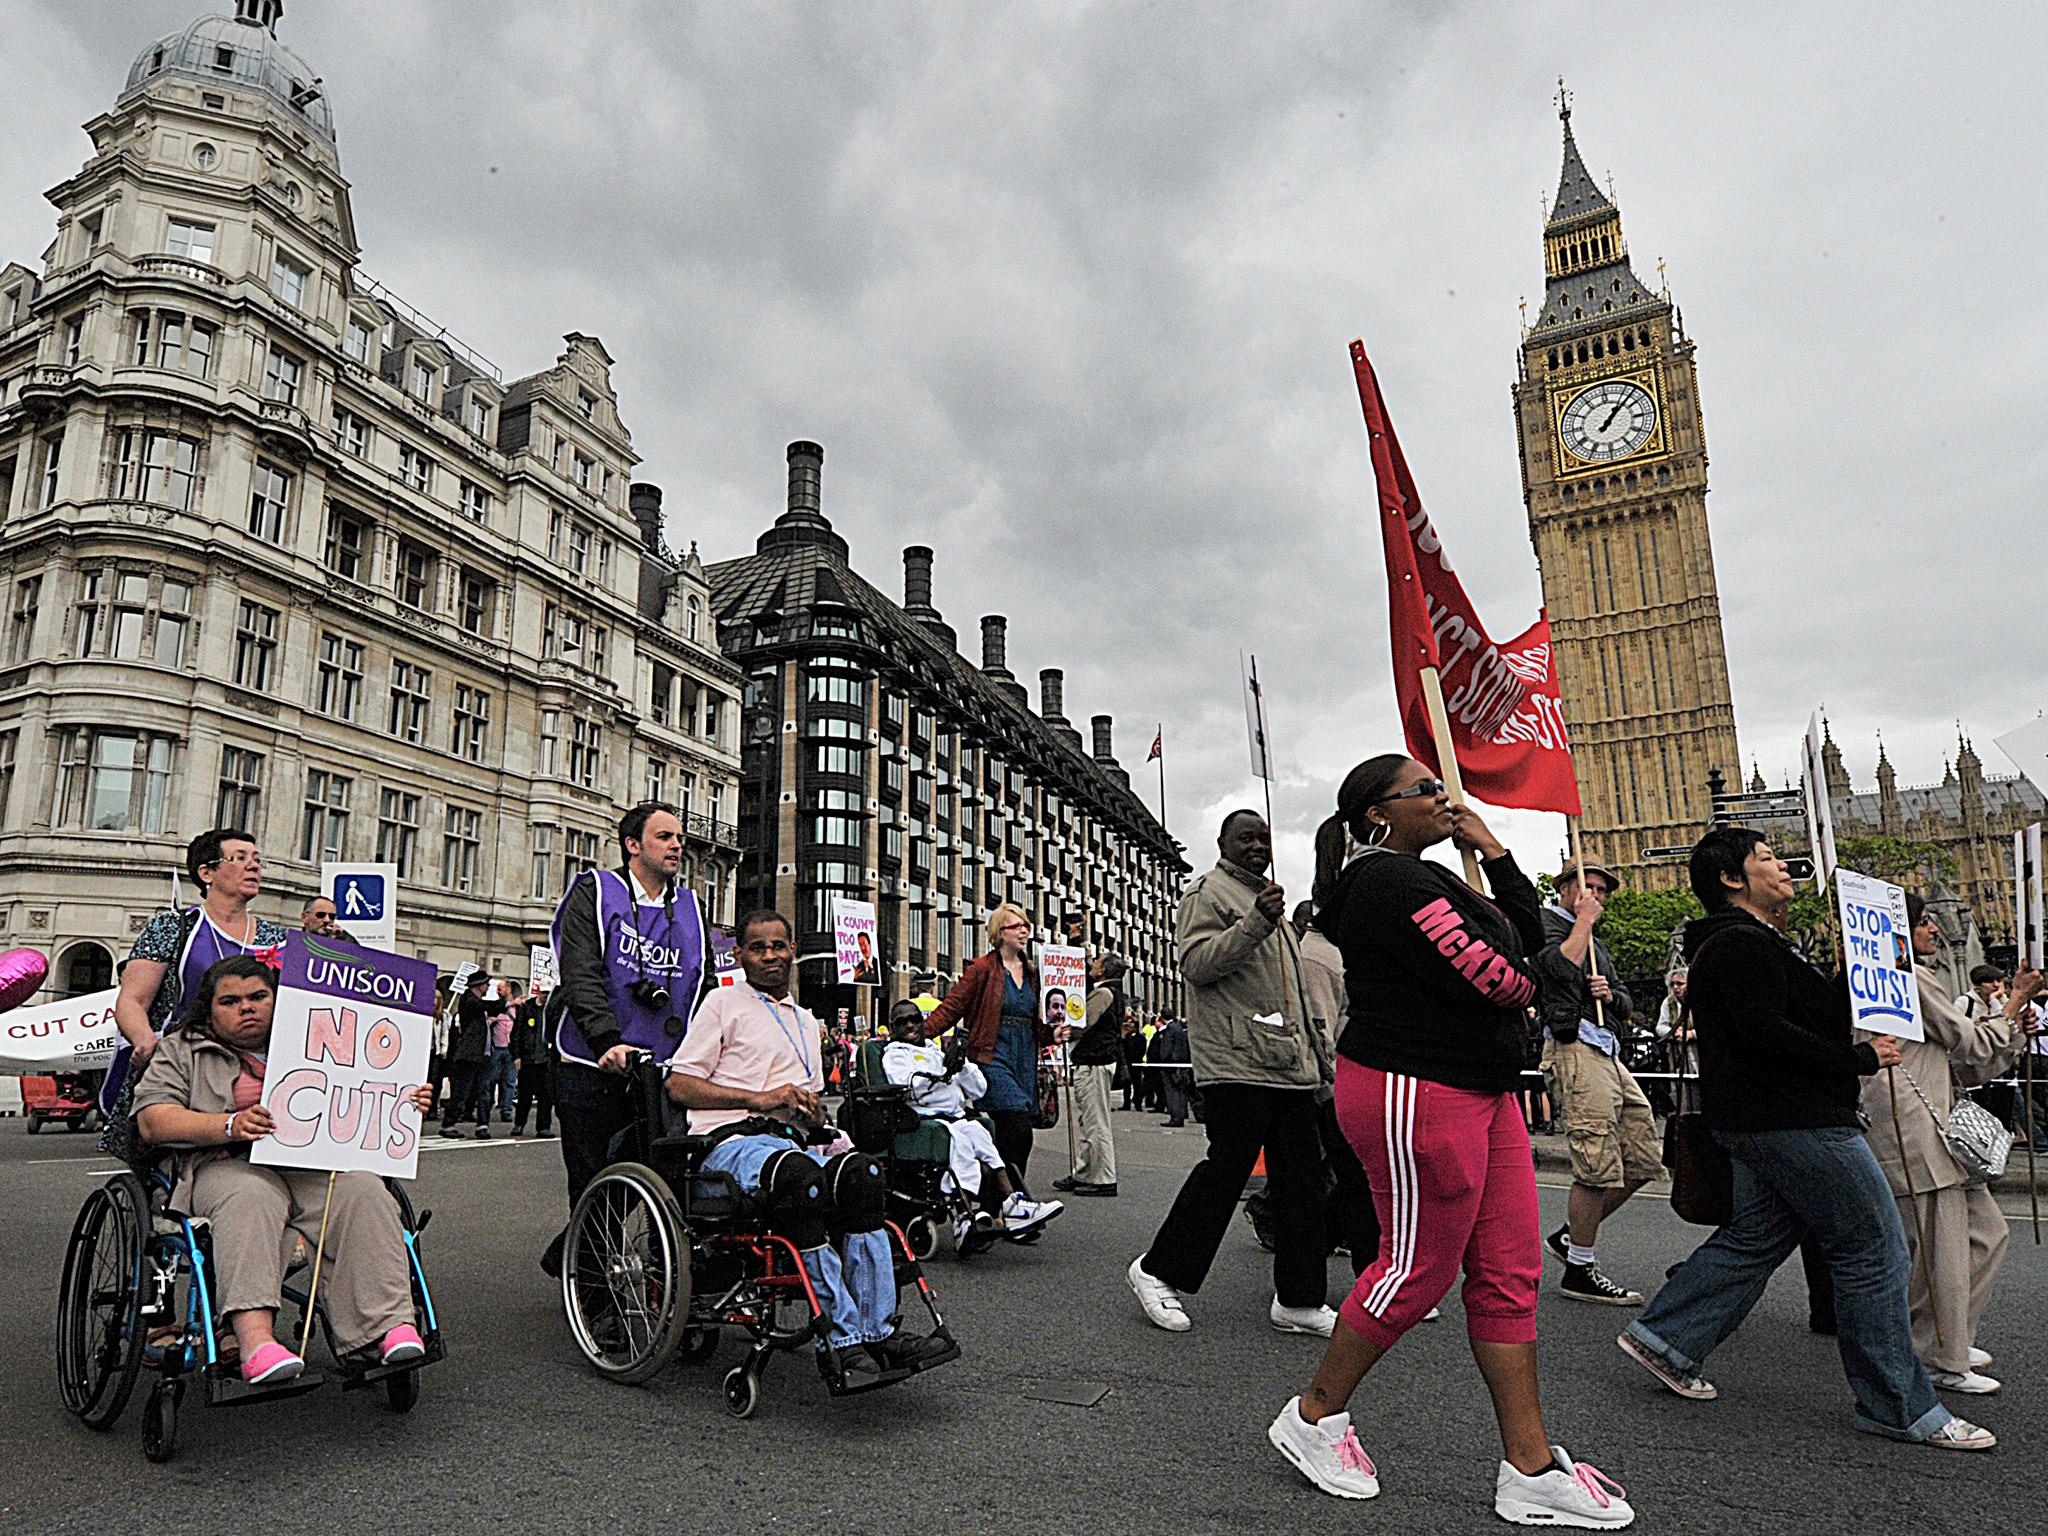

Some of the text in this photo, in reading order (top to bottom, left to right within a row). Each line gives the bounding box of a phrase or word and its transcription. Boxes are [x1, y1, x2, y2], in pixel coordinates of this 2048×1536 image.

[843, 916, 875, 932] COUNT
[1846, 902, 1893, 938] STOP
[837, 931, 856, 946] TOO
[1849, 935, 1880, 961] THE
[838, 949, 861, 965] DAVE
[306, 957, 415, 1003] UNISON
[1056, 967, 1066, 977] TO
[1850, 963, 1911, 1009] CUTS!
[8, 1018, 69, 1039] CUT
[304, 1006, 402, 1071] NO
[74, 1055, 90, 1063] the
[267, 1067, 420, 1160] CUTS
